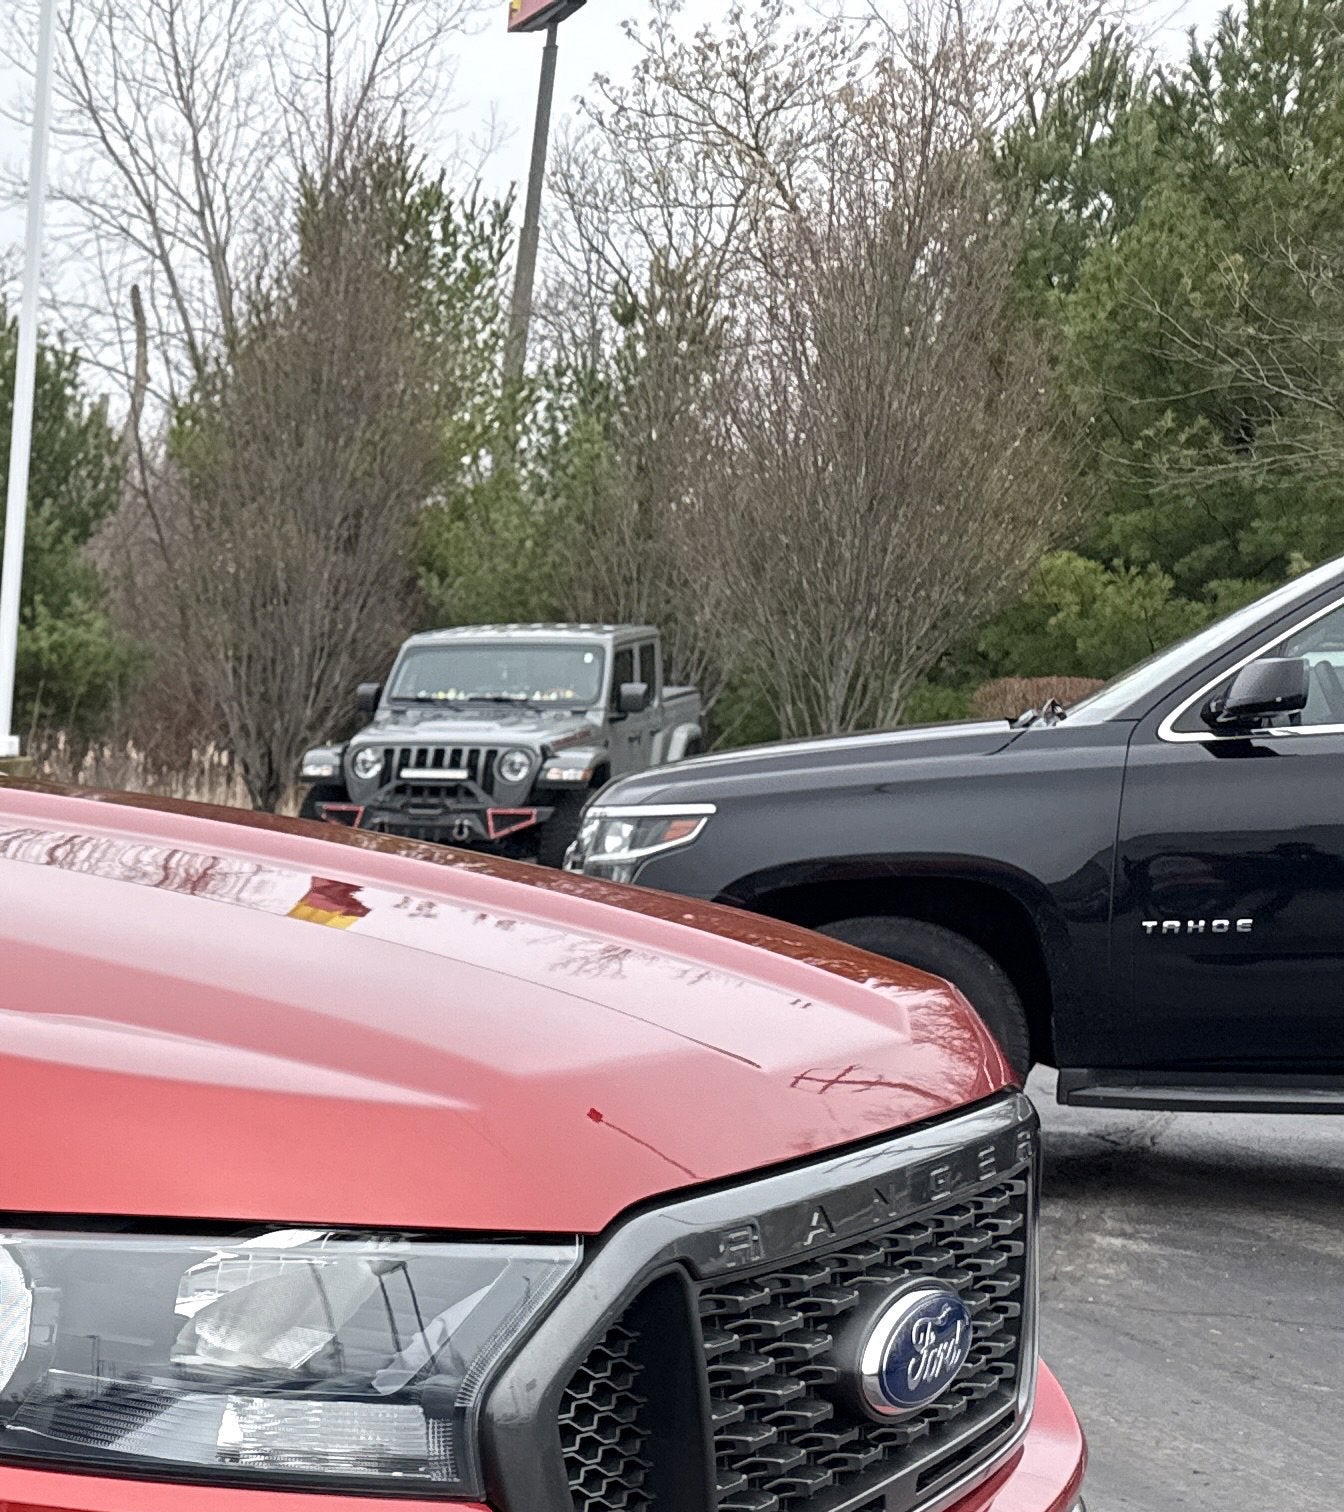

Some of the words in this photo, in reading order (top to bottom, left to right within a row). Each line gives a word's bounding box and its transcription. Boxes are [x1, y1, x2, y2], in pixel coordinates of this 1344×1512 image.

[1141, 918, 1253, 934] TAHOE
[719, 1128, 1032, 1268] RANGER
[907, 1302, 962, 1391] Ford
